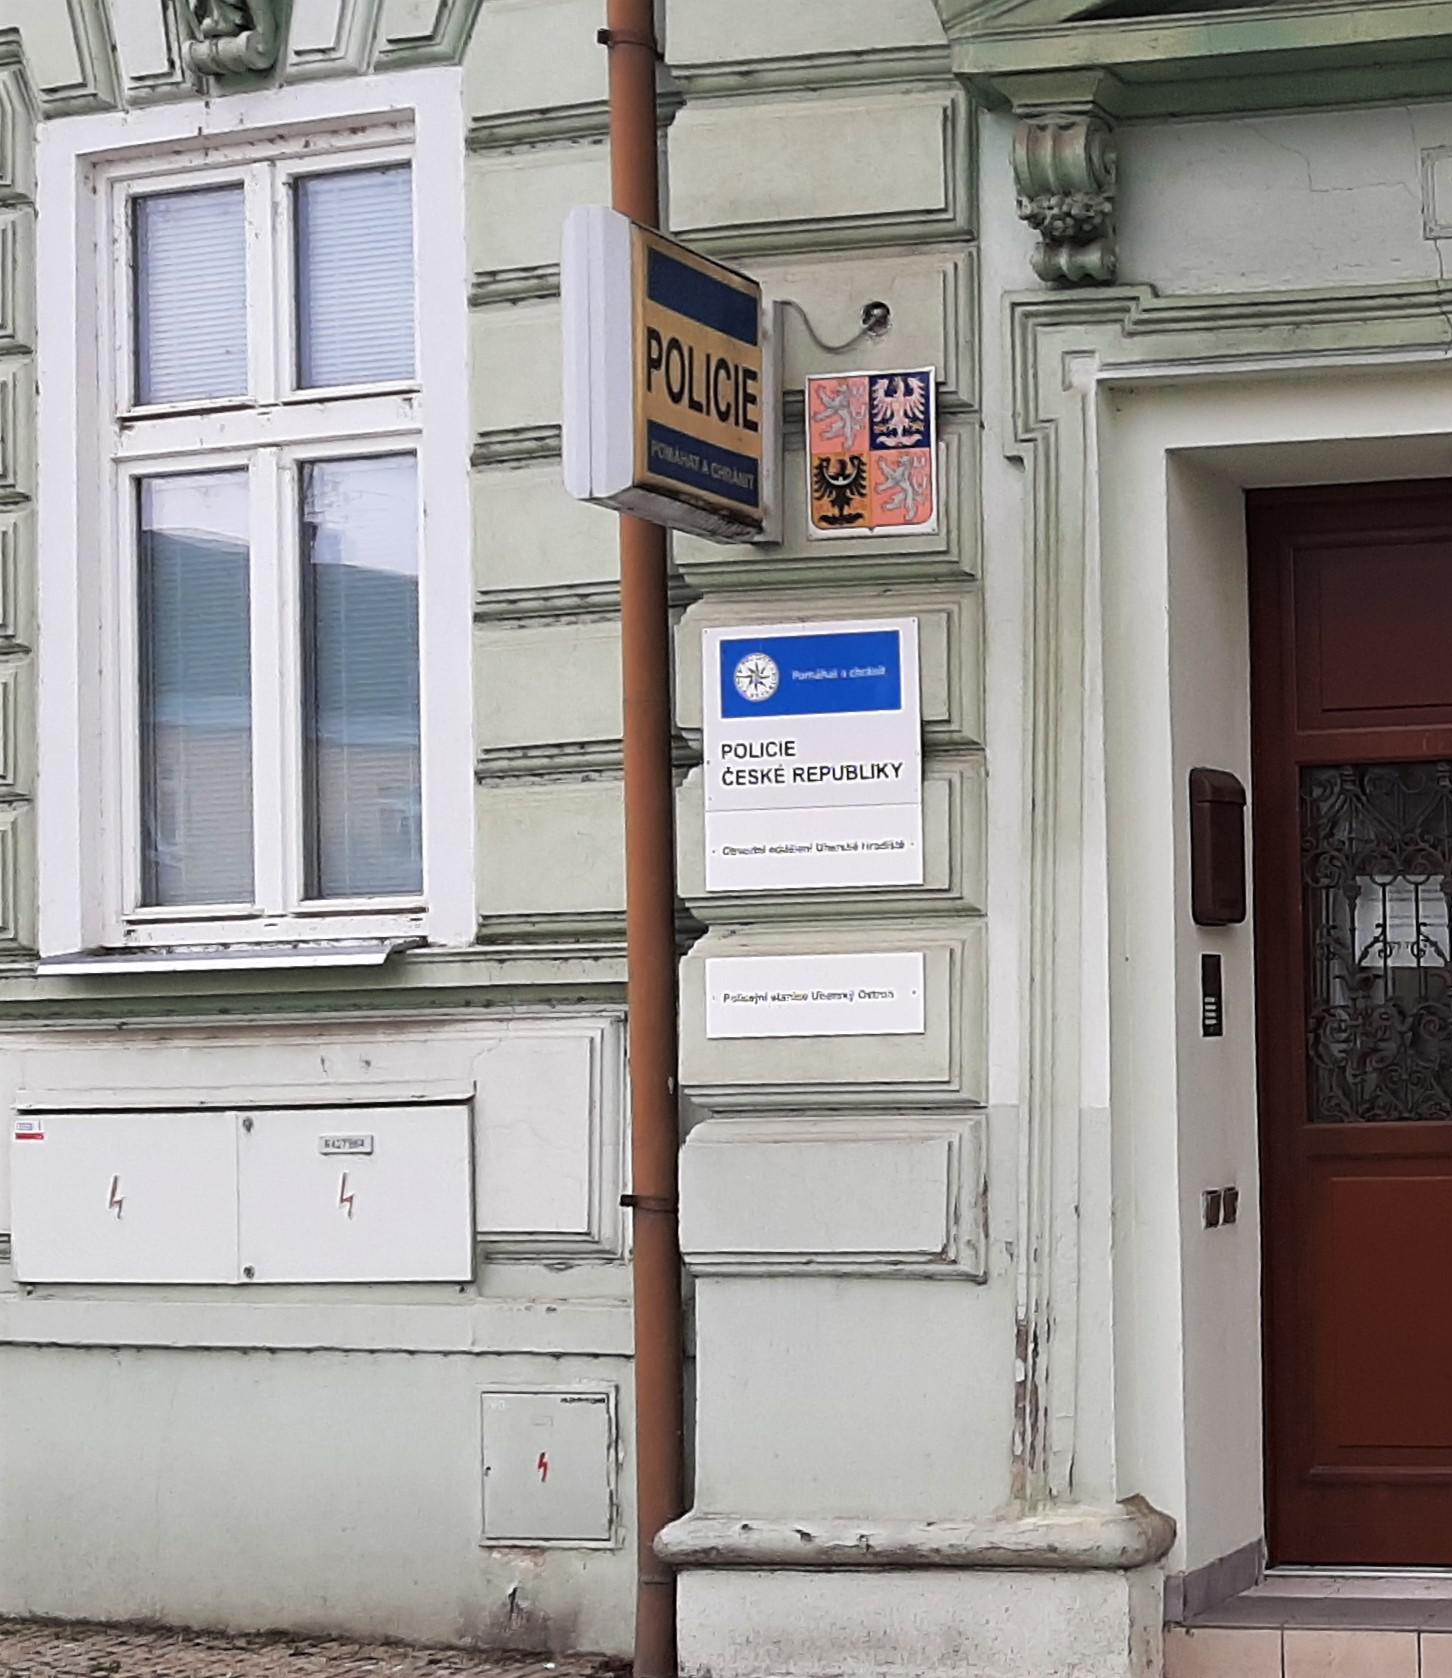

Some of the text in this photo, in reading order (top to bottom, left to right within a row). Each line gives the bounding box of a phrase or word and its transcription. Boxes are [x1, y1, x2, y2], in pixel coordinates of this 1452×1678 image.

[646, 327, 759, 433] POLICIE
[721, 741, 796, 759] POLICIE
[721, 762, 903, 786] ČESKÉ REPUBLIKY
